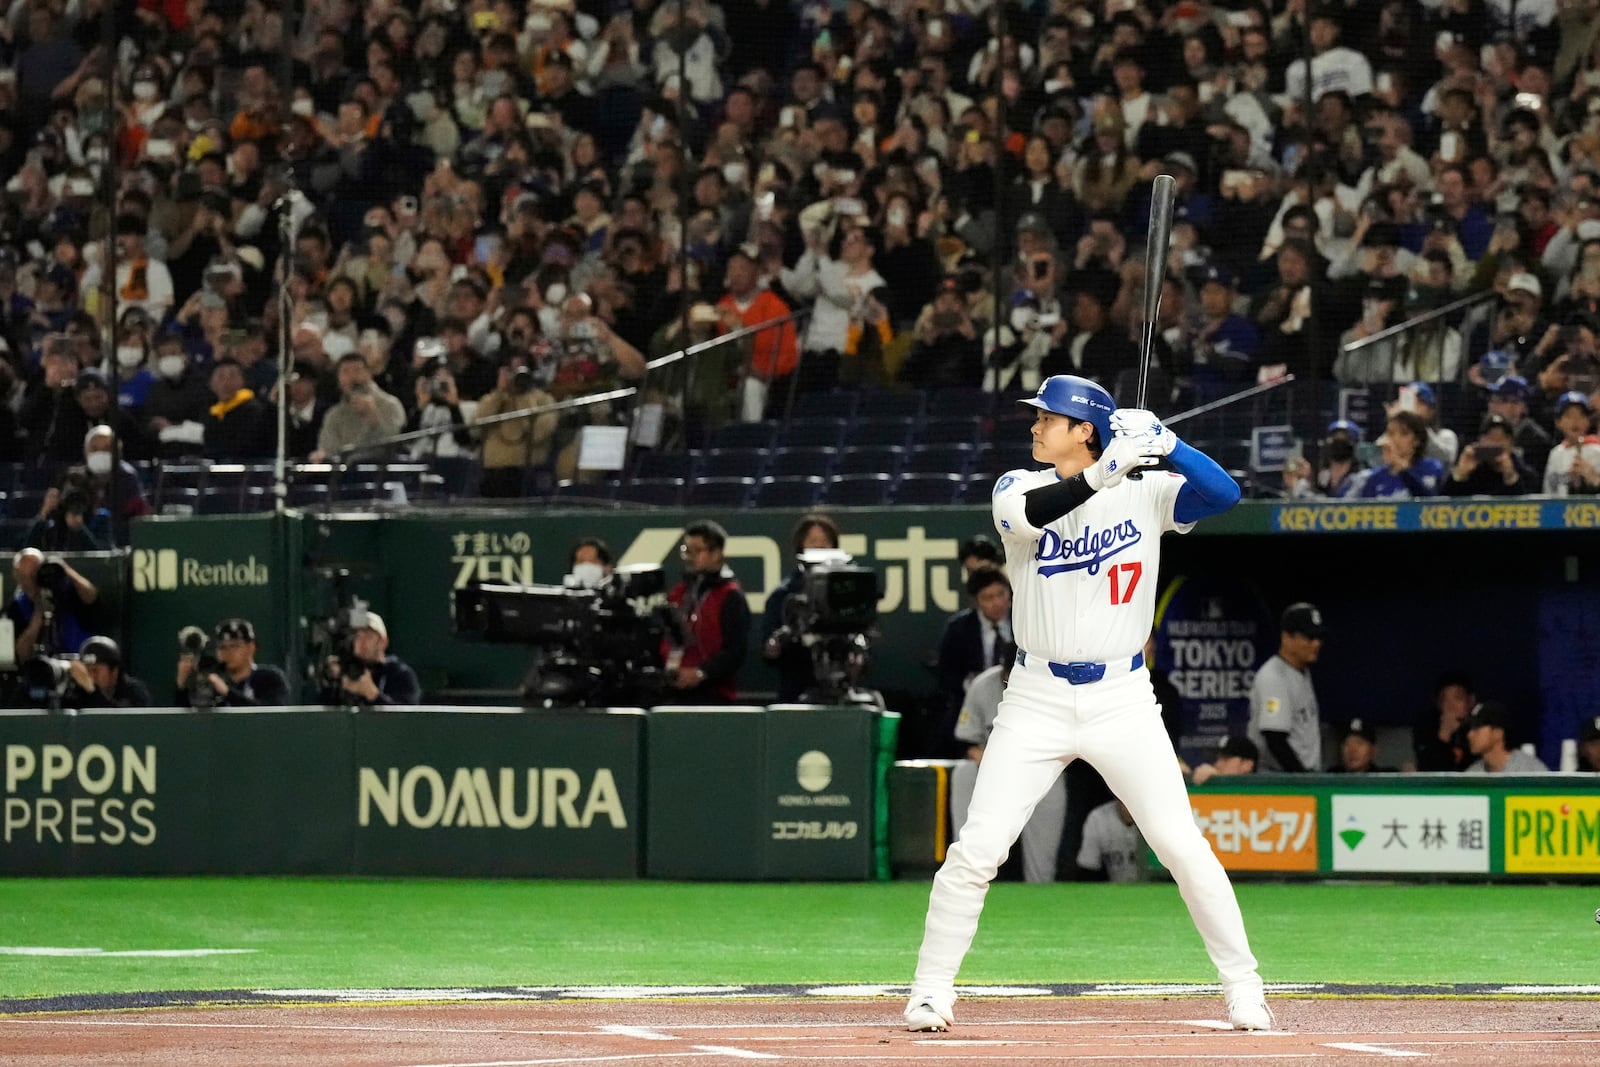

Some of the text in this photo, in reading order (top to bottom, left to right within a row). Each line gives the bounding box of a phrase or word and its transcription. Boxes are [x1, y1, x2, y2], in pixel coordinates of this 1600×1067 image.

[451, 531, 531, 555] すまいの
[1035, 519, 1142, 577] Dodgers
[183, 555, 269, 586] Rentola
[450, 555, 533, 589] ZEN
[1107, 561, 1143, 605] 17
[1169, 639, 1256, 668] TOKYO
[1168, 670, 1255, 699] SERIES
[6, 743, 156, 795] PPON
[359, 764, 627, 830] NOMURA
[4, 797, 156, 846] PRESS
[772, 821, 858, 840] コニカミノルタ
[1381, 817, 1484, 851] 大林組
